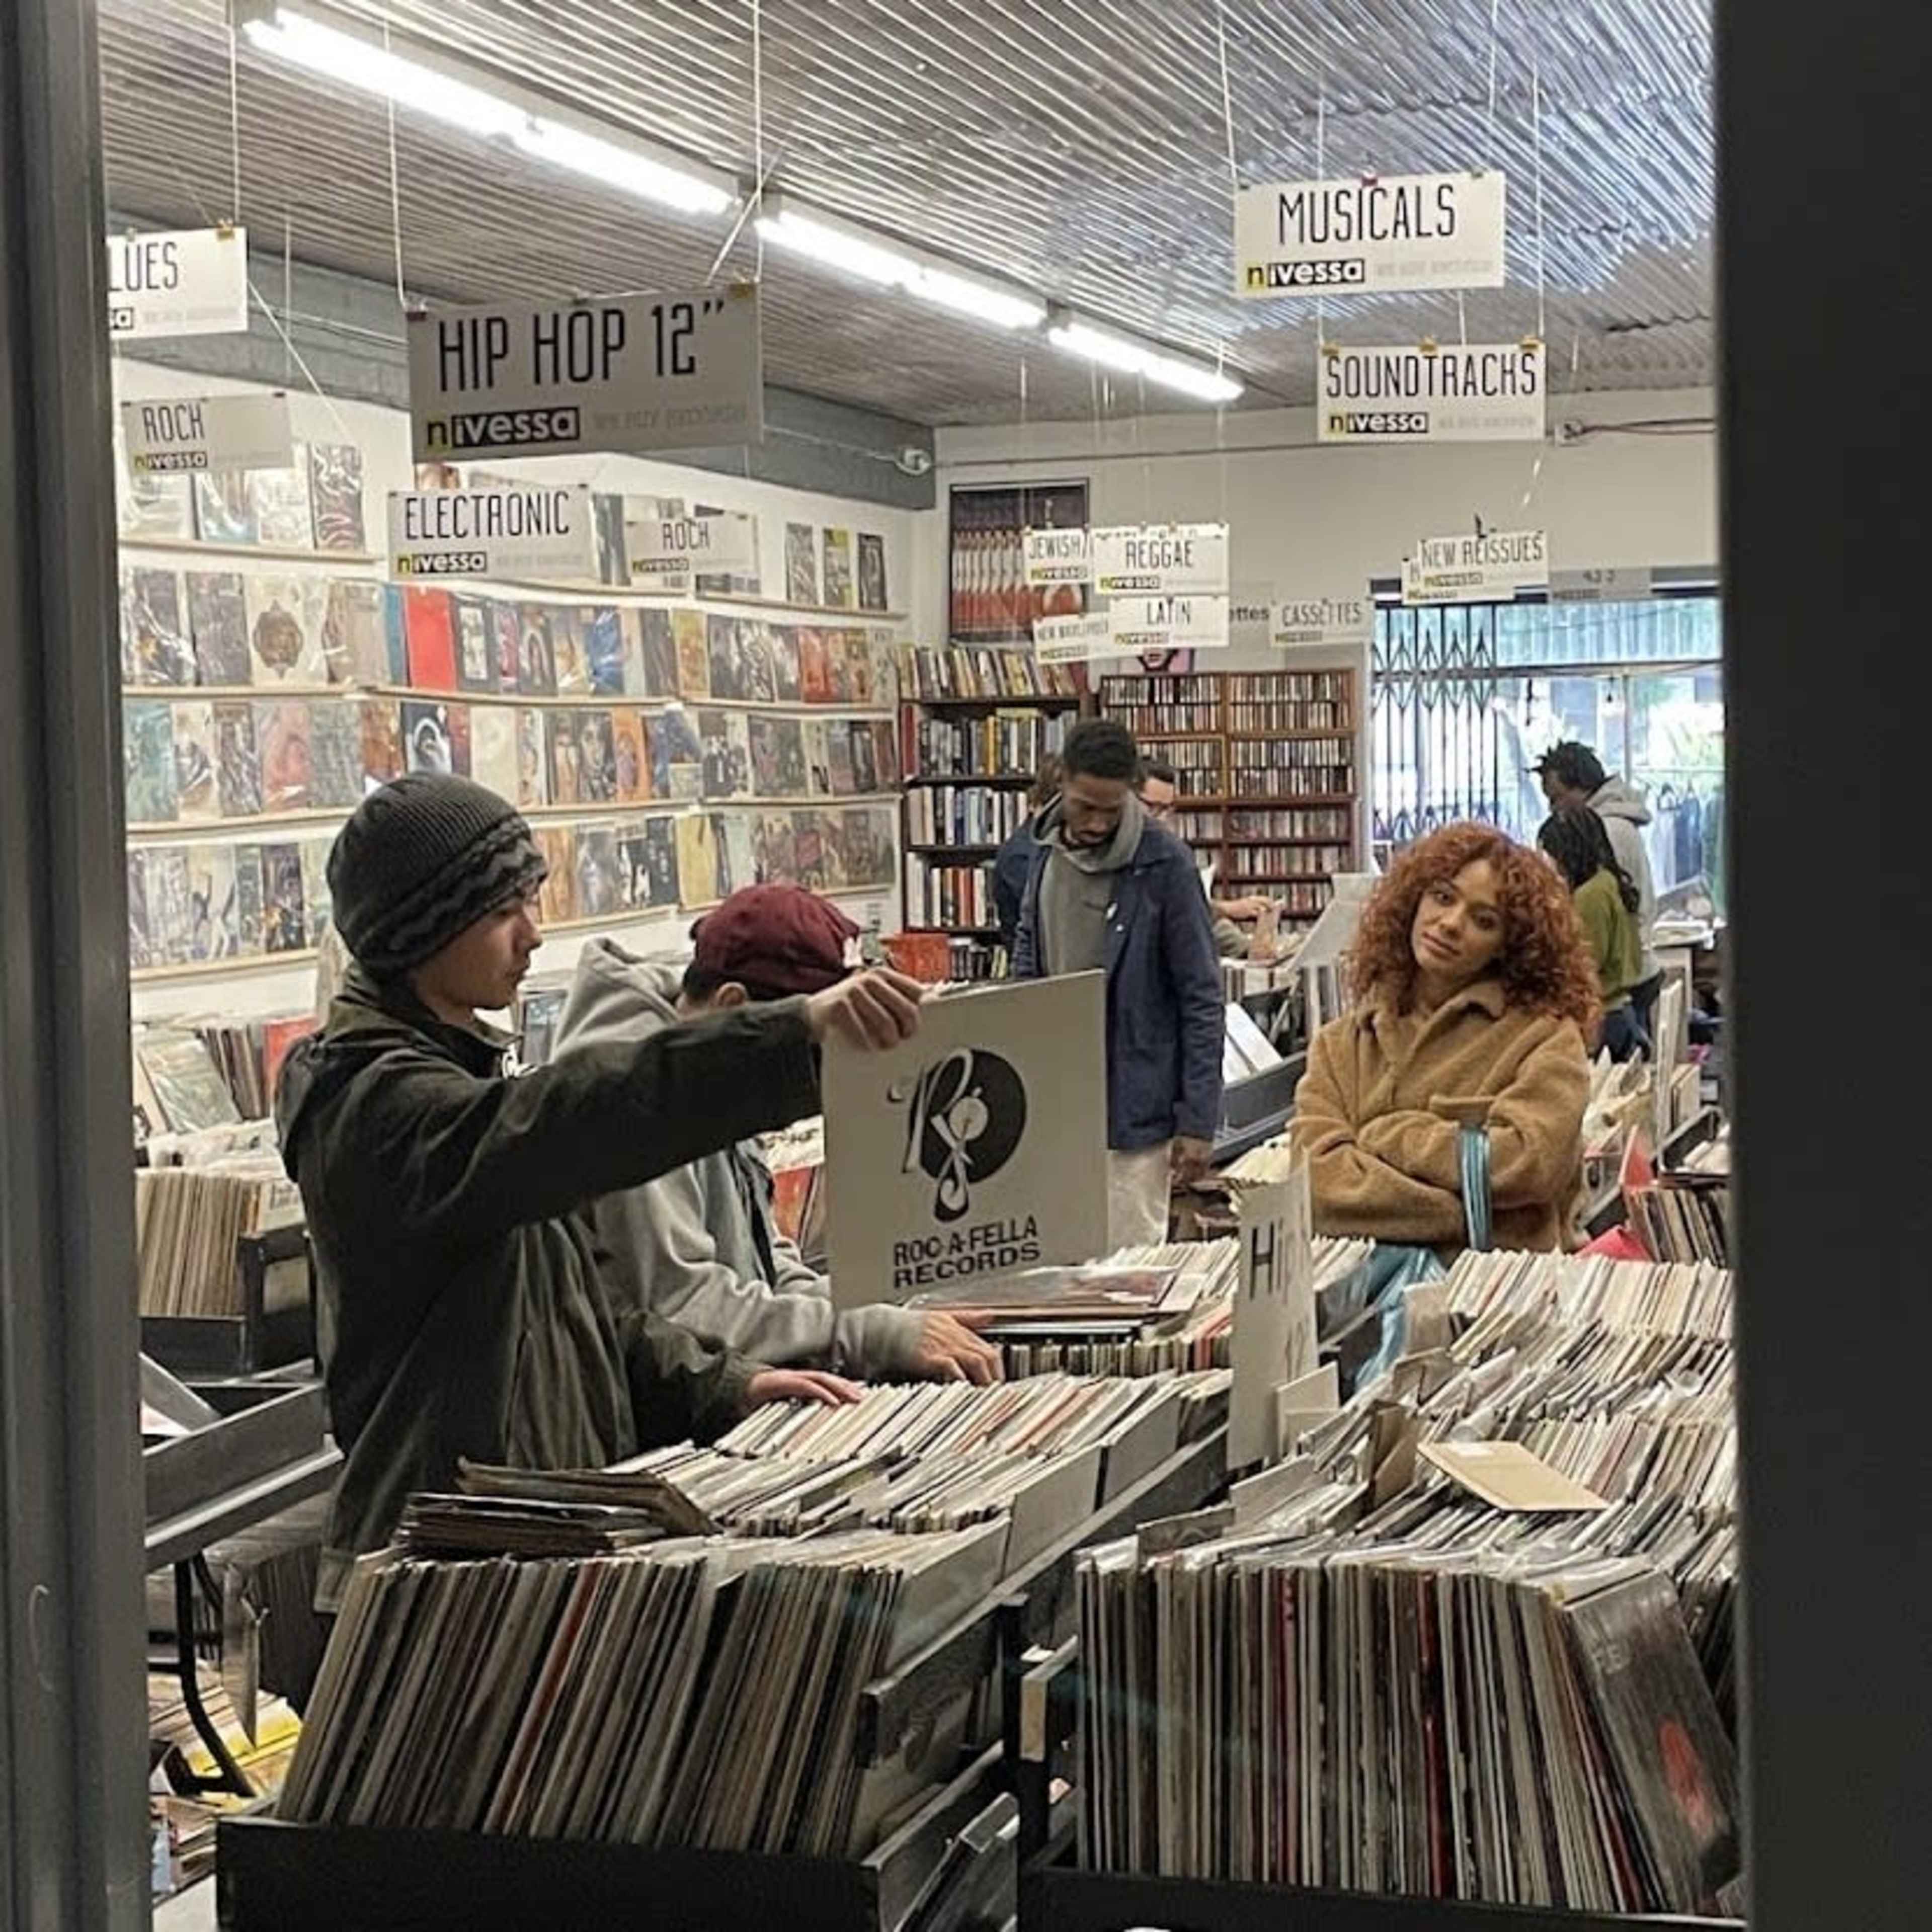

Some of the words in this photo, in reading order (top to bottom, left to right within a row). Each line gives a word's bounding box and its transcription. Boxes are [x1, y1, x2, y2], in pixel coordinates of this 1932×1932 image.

[1279, 184, 1455, 244] MUSICALS
[1248, 259, 1365, 287] nivessa
[439, 316, 509, 391] HIP
[533, 308, 625, 385] HOP
[427, 407, 580, 447] nivessa
[1331, 411, 1428, 434] nivessa
[134, 451, 207, 470] nivessa
[405, 491, 570, 540] ELECTRONIC
[398, 552, 488, 574] nivessa
[1125, 539, 1194, 569] REGGAE
[1421, 539, 1456, 569] NEW
[1463, 534, 1543, 566] REISSUES
[1146, 599, 1191, 625] LATIN
[1282, 602, 1361, 627] CASSETTES
[894, 1241, 1040, 1289] RECORDS
